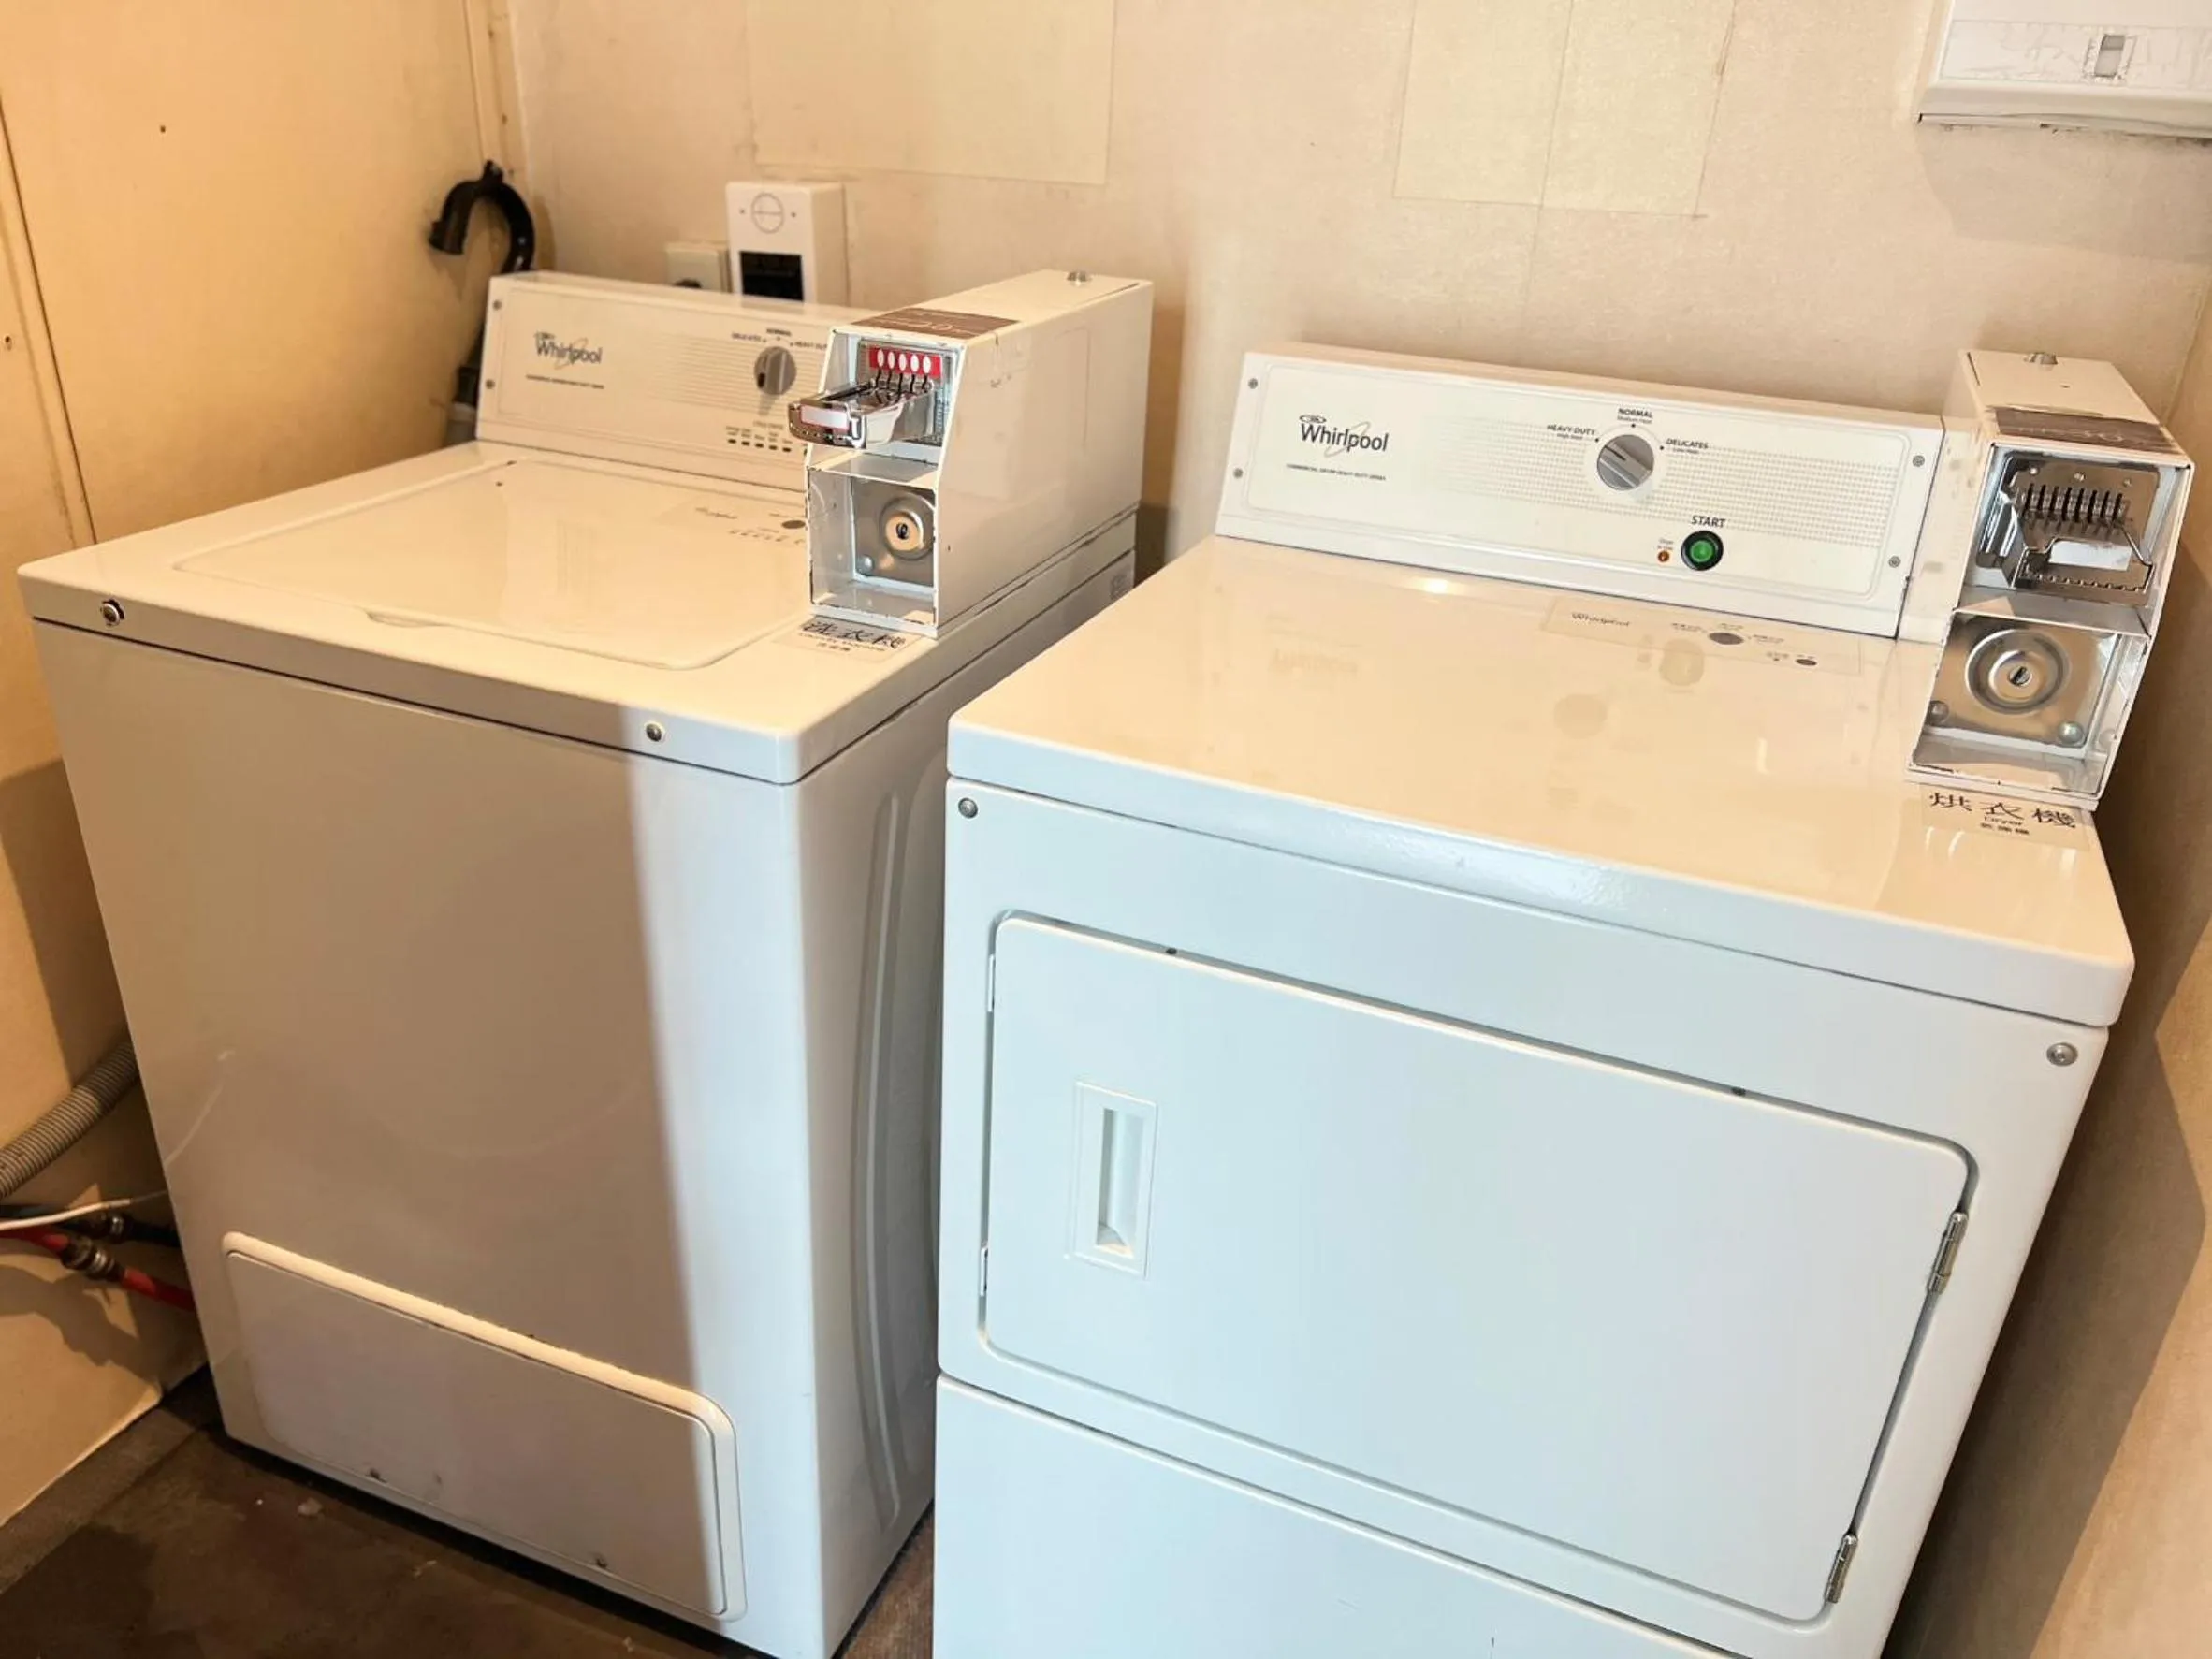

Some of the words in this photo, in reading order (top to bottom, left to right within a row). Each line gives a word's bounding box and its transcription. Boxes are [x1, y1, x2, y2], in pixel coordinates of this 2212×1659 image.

[535, 335, 604, 365] Whirlpool
[1618, 407, 1653, 419] NORMAL
[1546, 424, 1572, 434] HEAVY
[1573, 427, 1595, 436] DUTY
[1301, 423, 1390, 453] Whirlpool
[1665, 437, 1709, 450] DELICATES
[1691, 515, 1726, 528] START
[1929, 792, 2077, 829] 烘衣機
